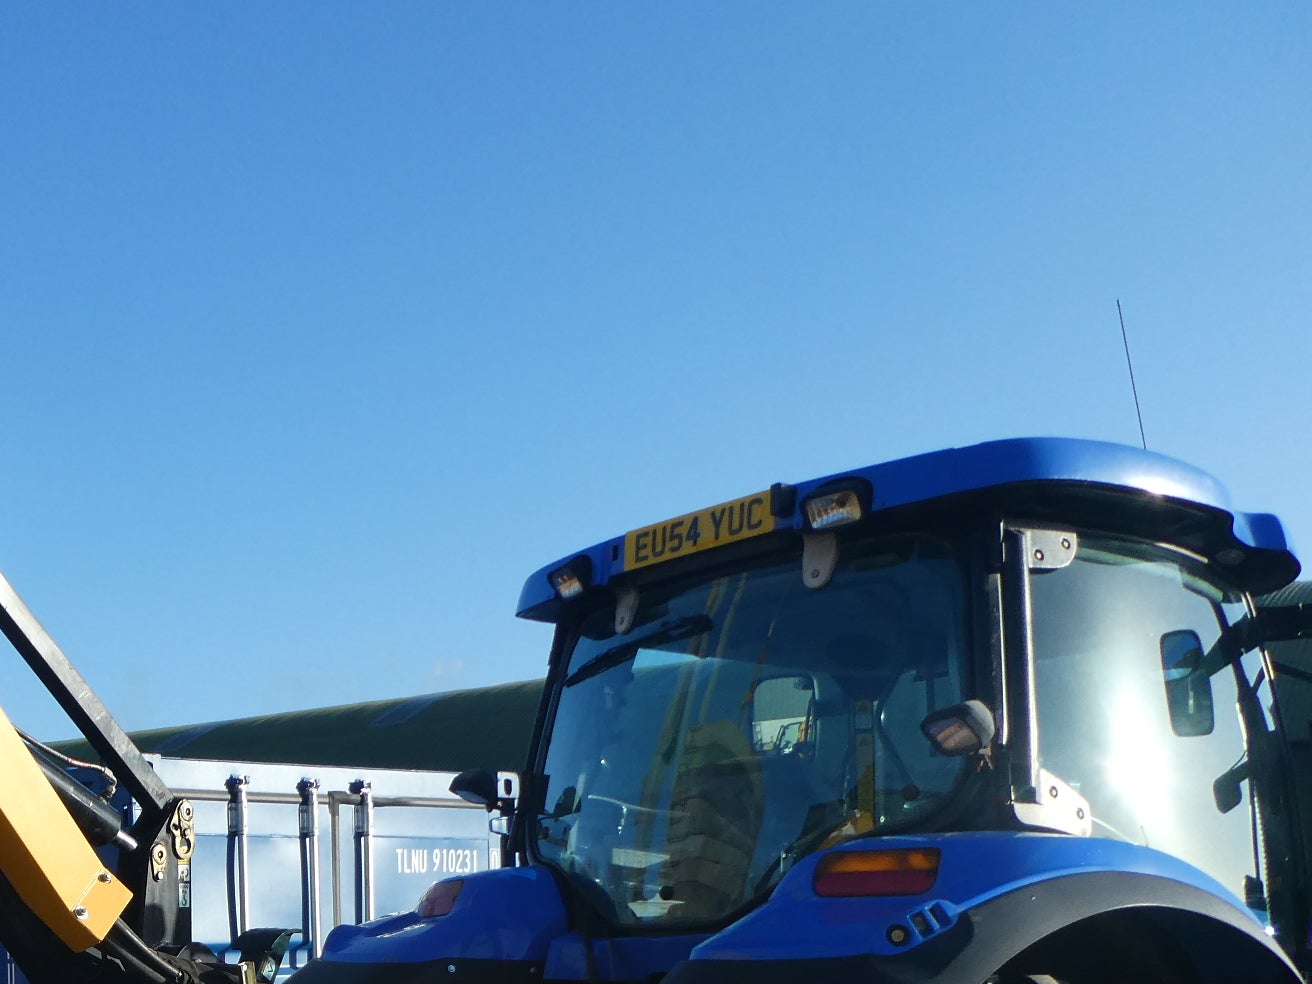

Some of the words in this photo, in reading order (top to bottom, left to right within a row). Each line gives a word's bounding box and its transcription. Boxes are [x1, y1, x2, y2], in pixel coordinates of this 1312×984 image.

[635, 516, 700, 563] EU54
[710, 498, 764, 540] YUC
[396, 848, 428, 874] TLNU
[432, 848, 478, 873] 910231
